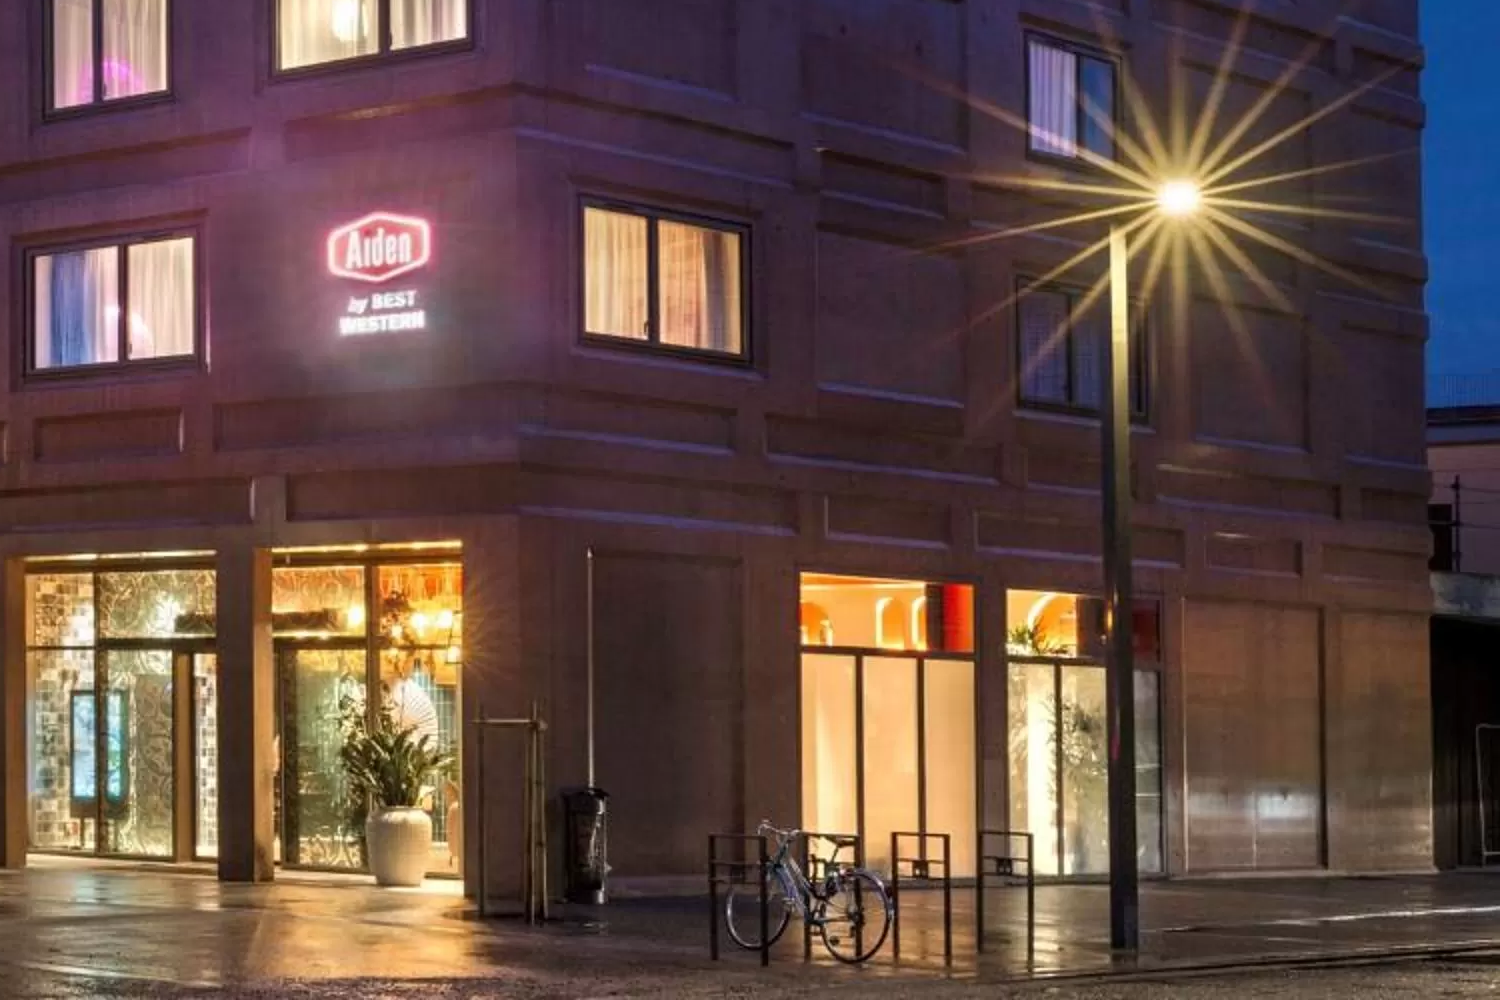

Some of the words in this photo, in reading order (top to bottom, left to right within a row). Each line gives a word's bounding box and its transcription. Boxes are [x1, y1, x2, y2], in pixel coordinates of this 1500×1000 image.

[345, 227, 411, 269] Aiden
[348, 297, 369, 314] by
[371, 290, 417, 310] BEST
[340, 310, 425, 336] WESTERN
